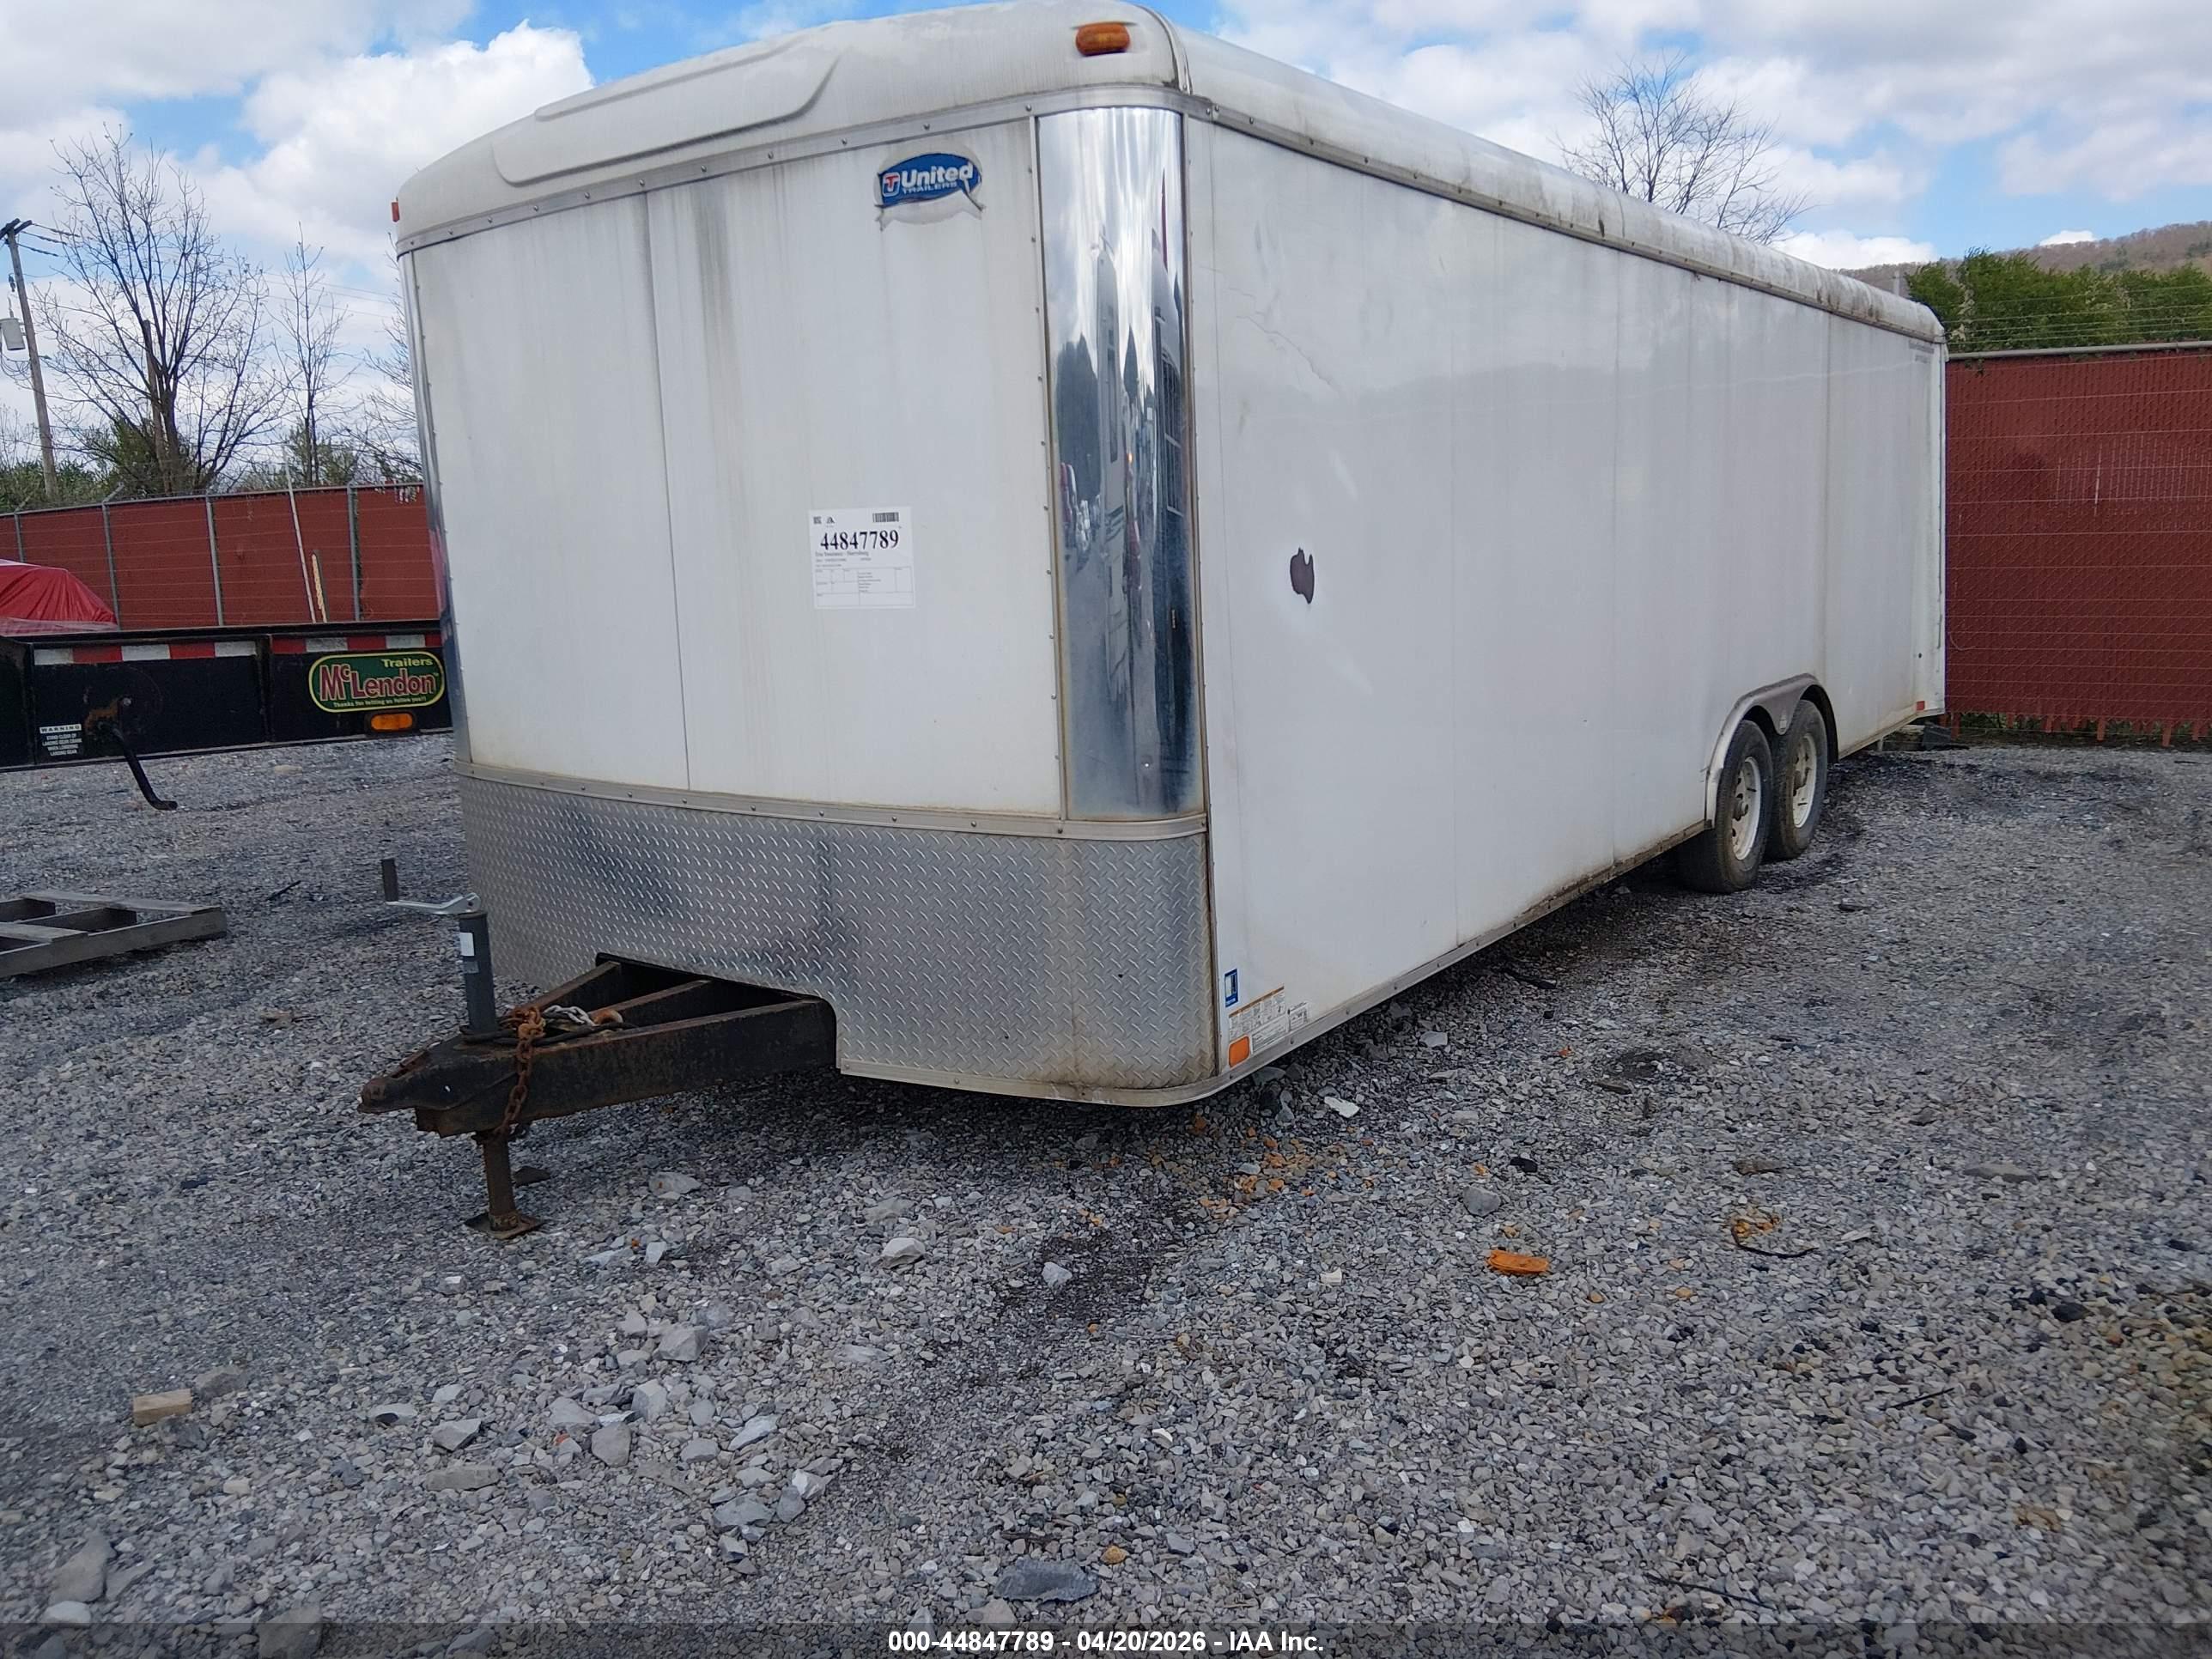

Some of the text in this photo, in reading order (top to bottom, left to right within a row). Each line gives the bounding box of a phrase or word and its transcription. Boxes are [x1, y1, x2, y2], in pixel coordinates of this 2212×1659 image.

[902, 161, 973, 187] United
[902, 181, 957, 194] TRAILERS
[820, 530, 899, 550] 44847789
[382, 659, 434, 668] Trailers
